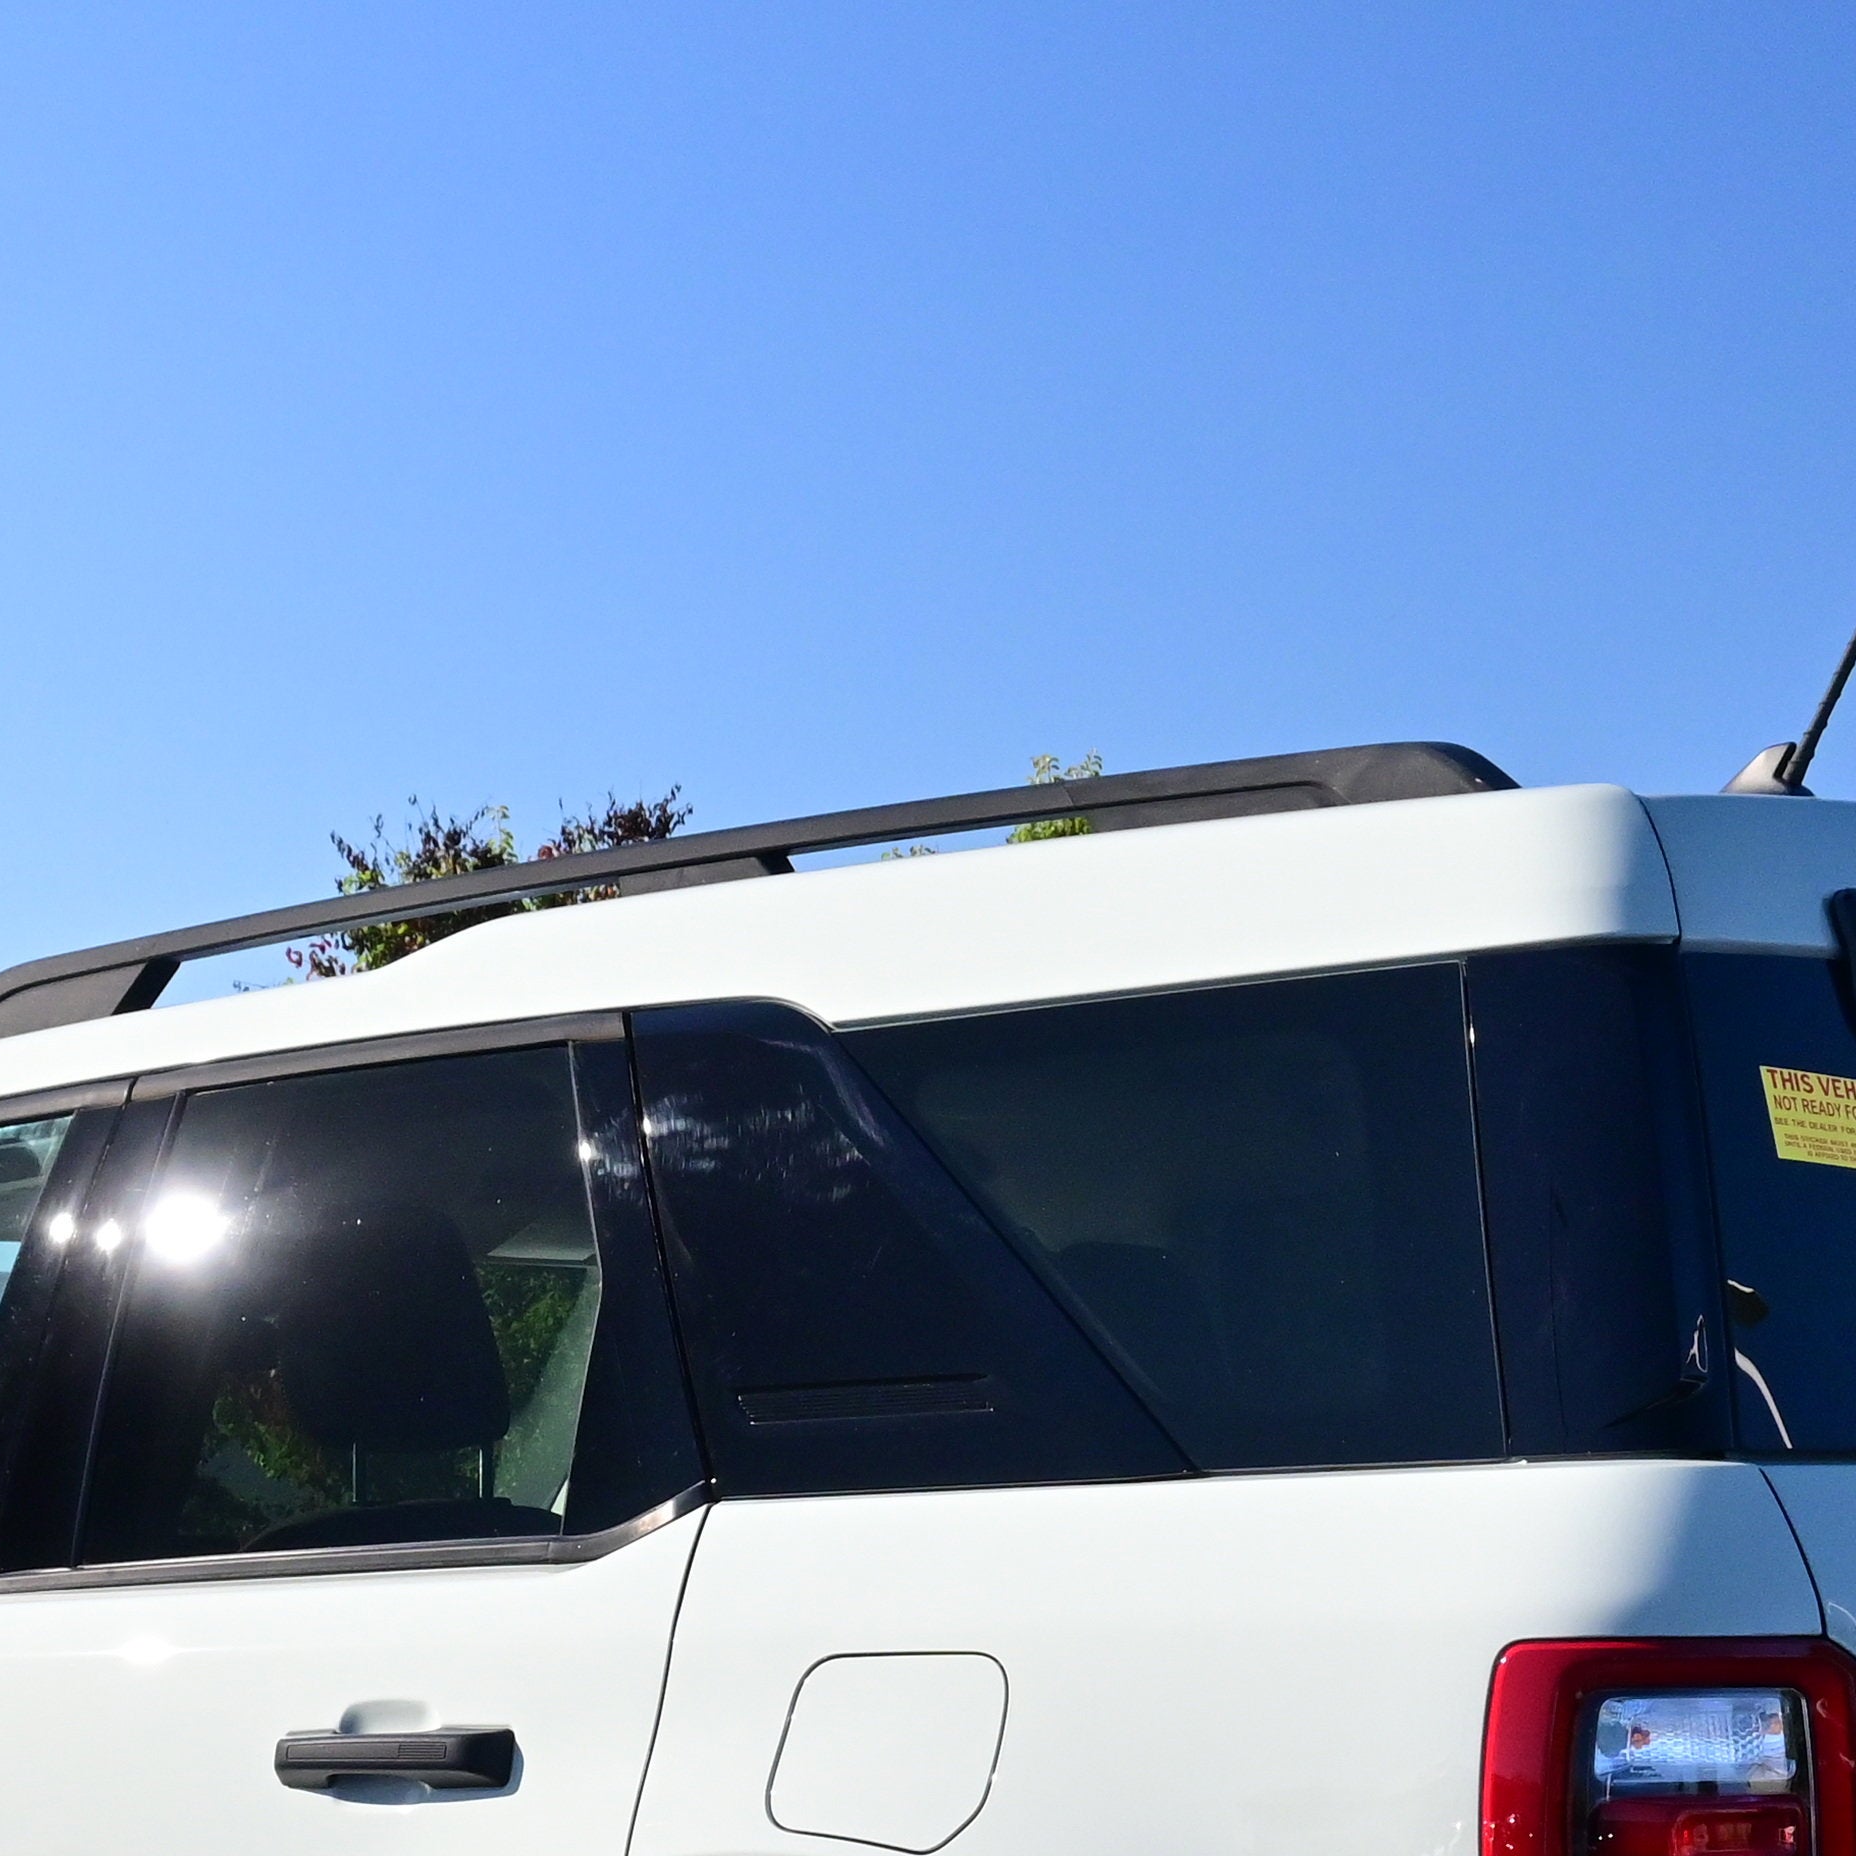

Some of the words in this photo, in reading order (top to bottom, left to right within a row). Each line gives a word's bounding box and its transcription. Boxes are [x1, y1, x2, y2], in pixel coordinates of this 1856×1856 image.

[1767, 1069, 1814, 1093] THIS
[1773, 1095, 1797, 1111] NOT
[1801, 1098, 1841, 1117] READY
[1774, 1117, 1789, 1126] SEE
[1791, 1119, 1807, 1128] THE
[1809, 1121, 1838, 1132] DEALER
[1841, 1126, 1856, 1135] FOR
